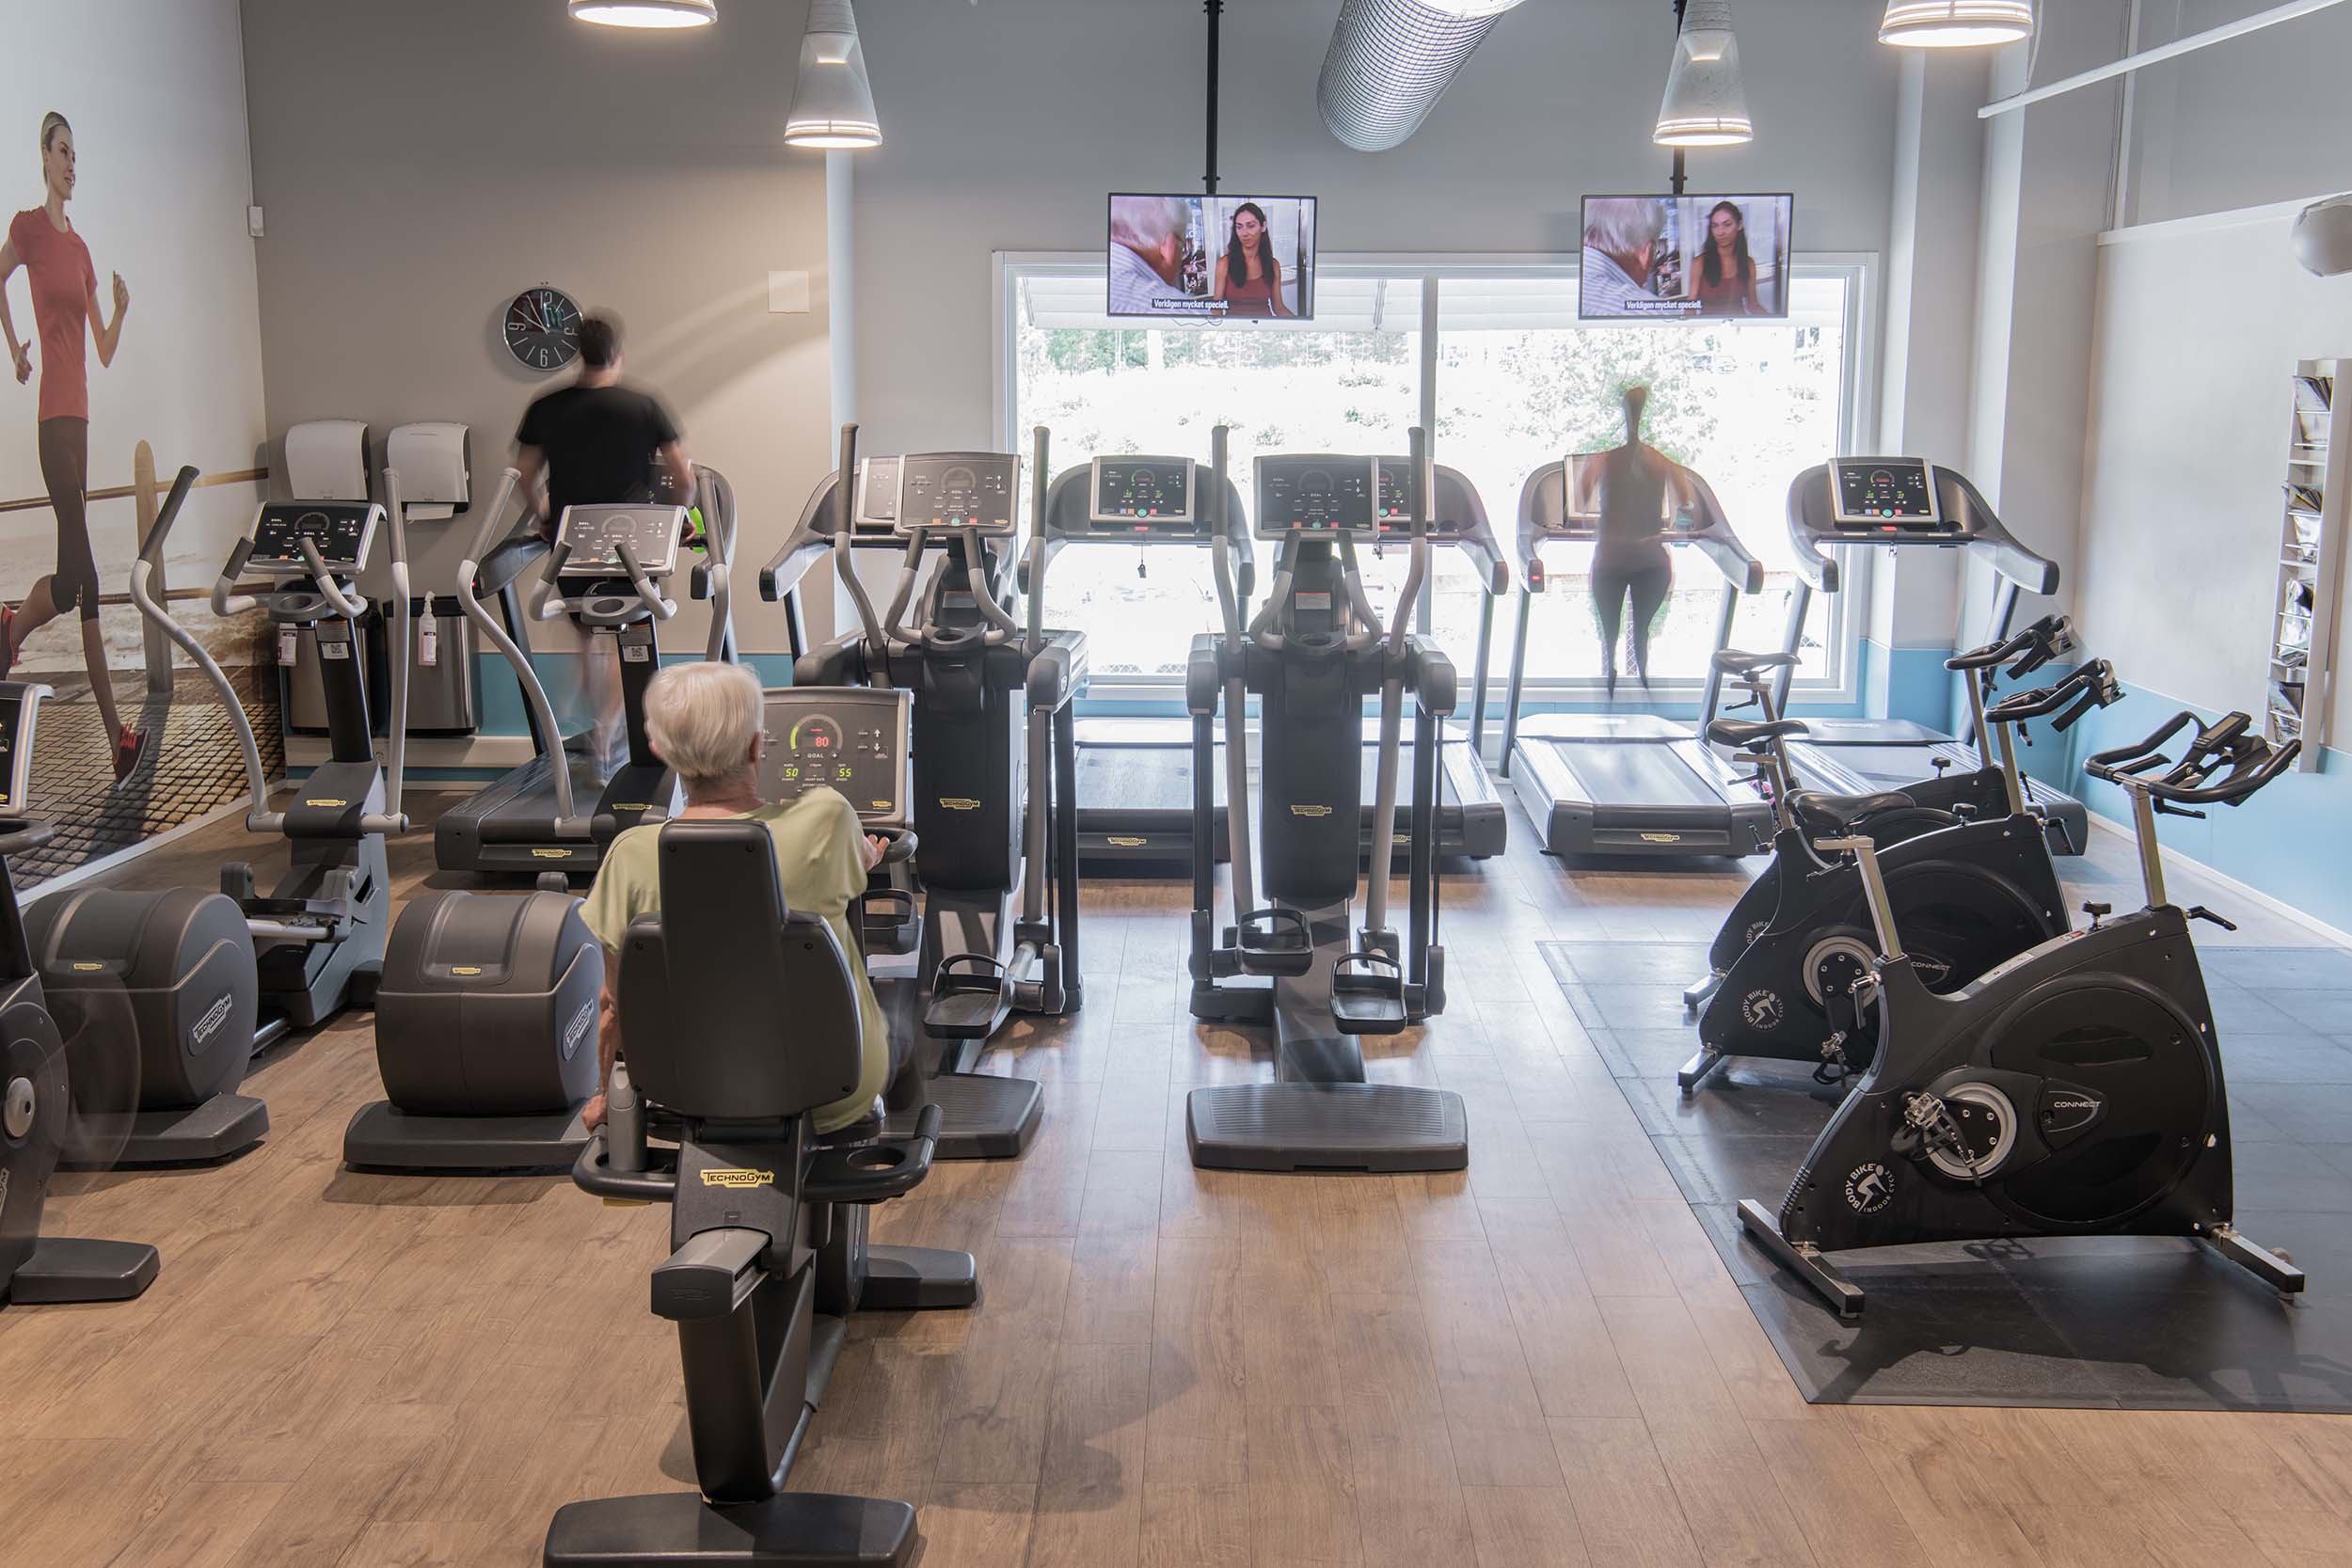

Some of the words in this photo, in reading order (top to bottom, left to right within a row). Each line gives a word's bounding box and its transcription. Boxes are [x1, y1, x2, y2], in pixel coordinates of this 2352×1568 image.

[1182, 300, 1204, 309] mycket
[1655, 301, 1677, 310] mycket
[815, 736, 829, 747] 80
[1911, 961, 1951, 971] CONNECT
[194, 995, 231, 1040] TECHNOGYM
[1742, 999, 1755, 1023] BODY
[702, 1170, 772, 1186] TECHNOGYM
[1850, 1163, 1875, 1180] BIKE
[1845, 1180, 1861, 1209] BODY
